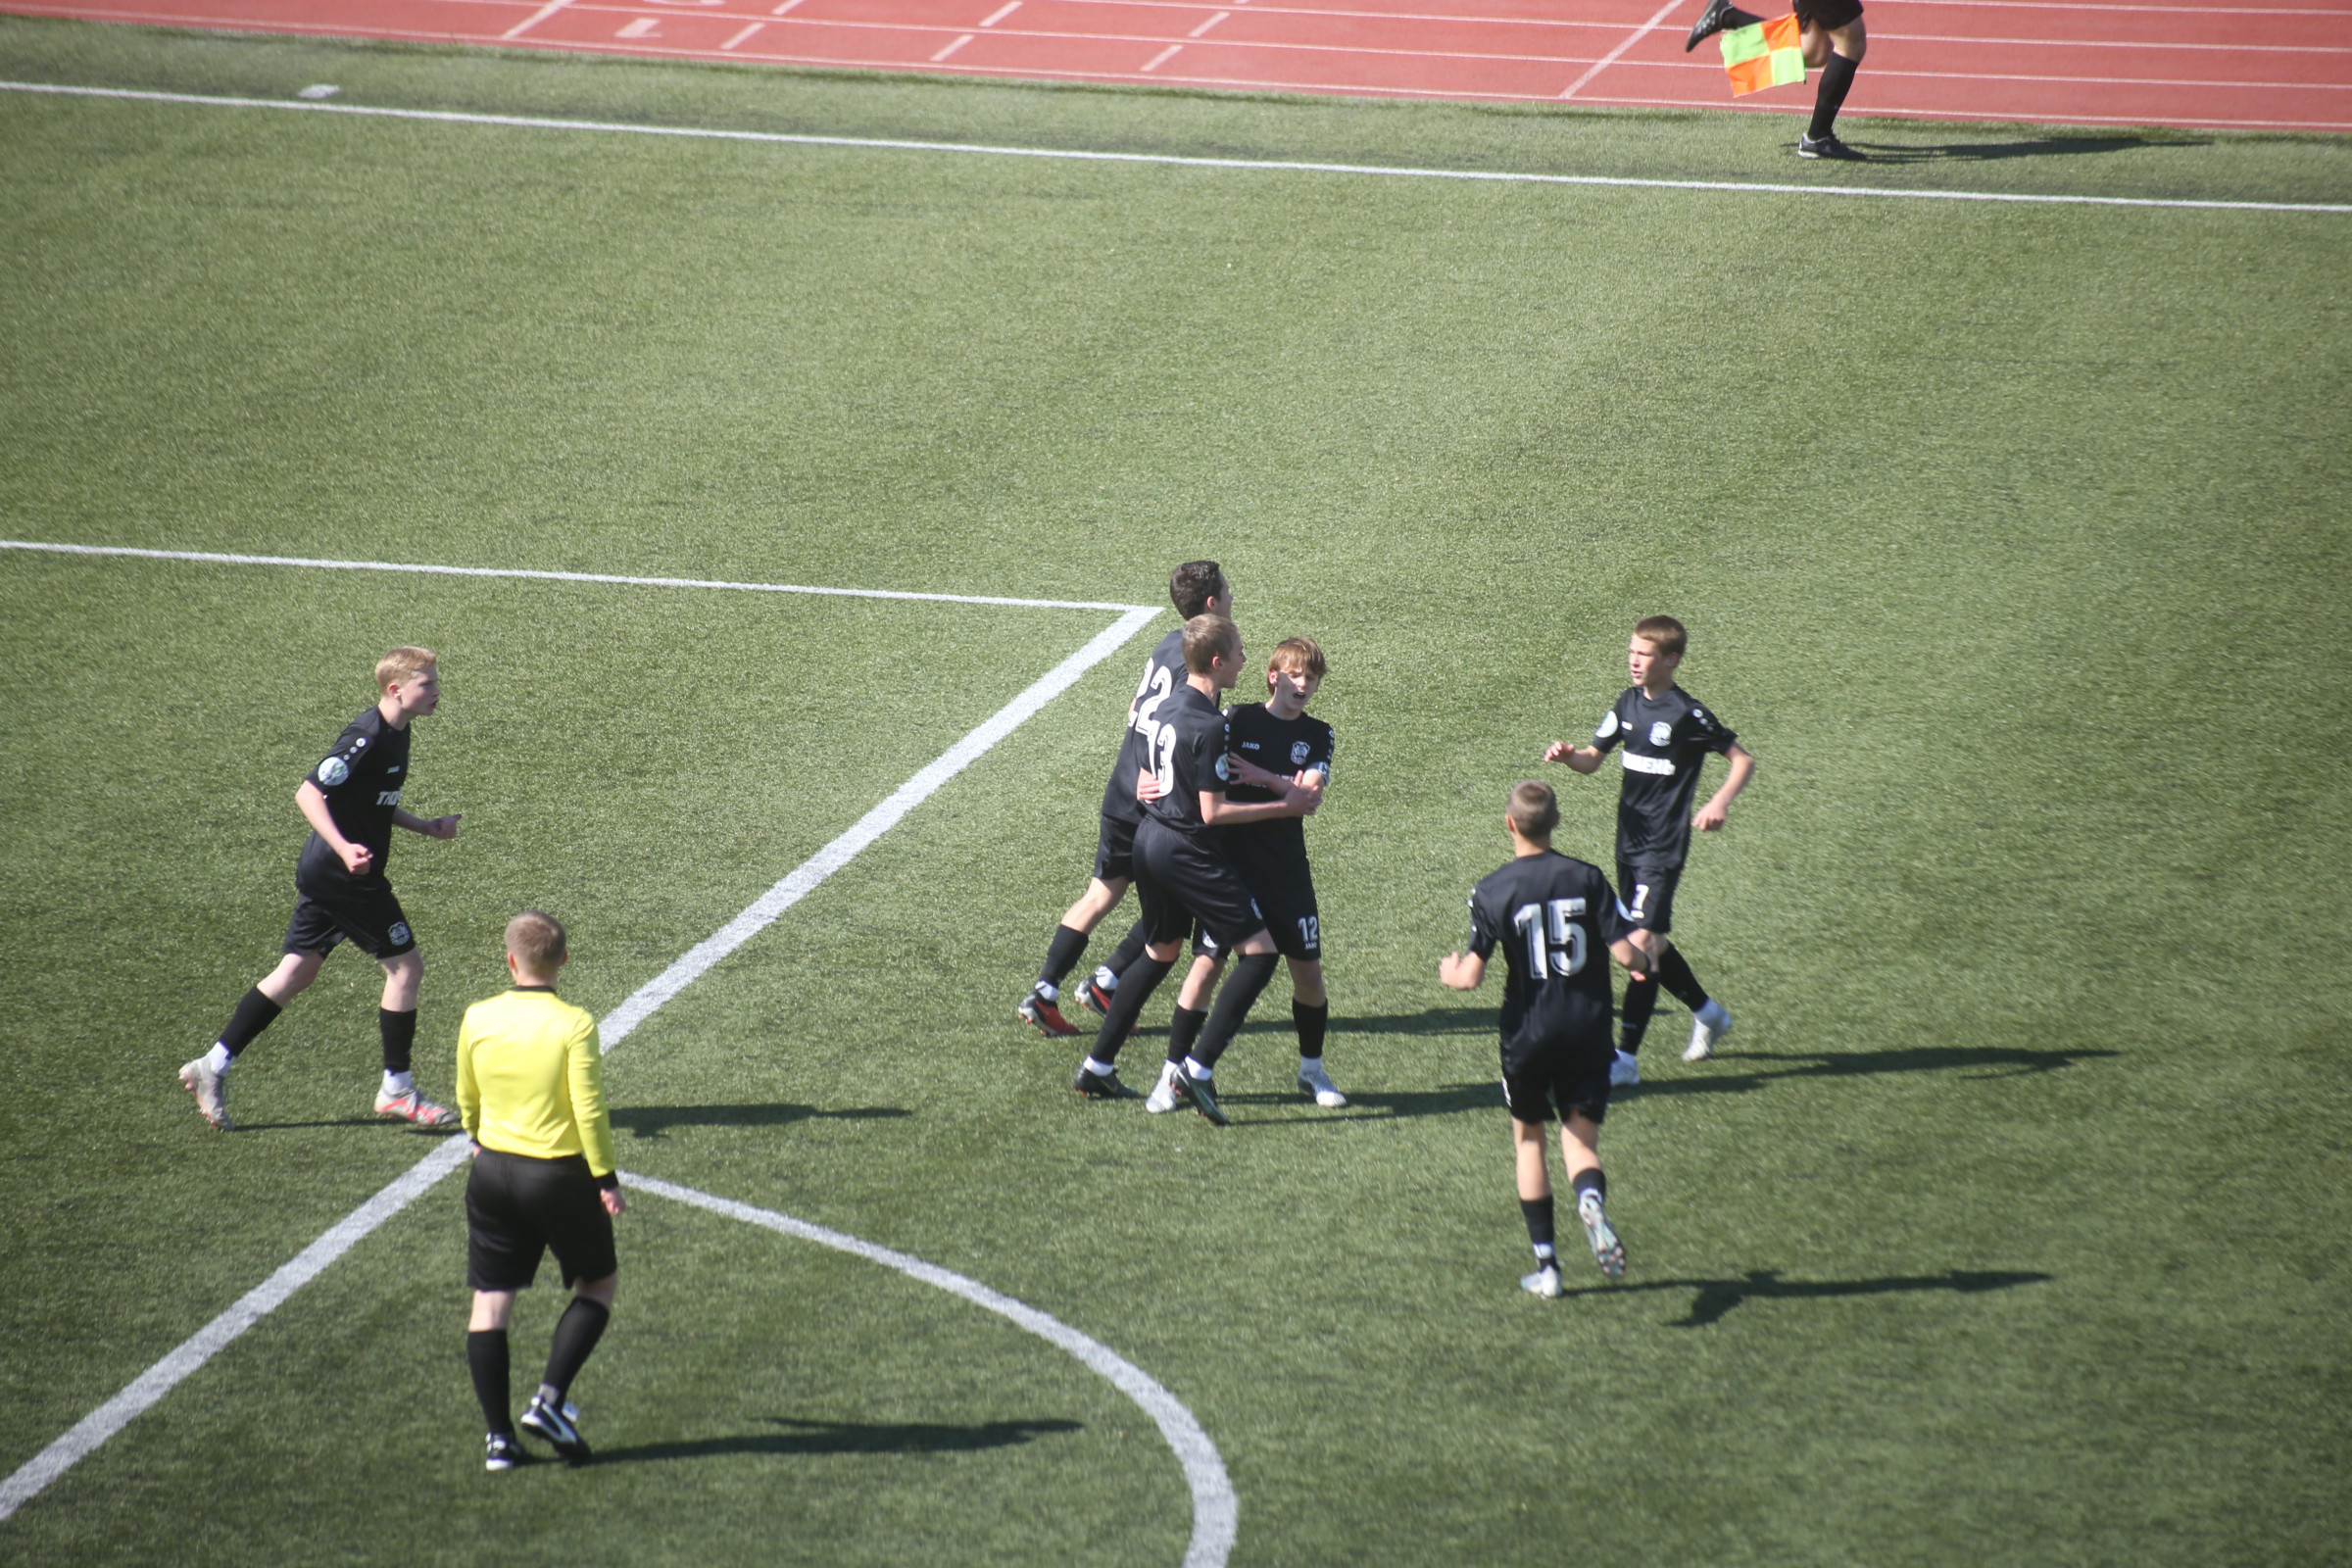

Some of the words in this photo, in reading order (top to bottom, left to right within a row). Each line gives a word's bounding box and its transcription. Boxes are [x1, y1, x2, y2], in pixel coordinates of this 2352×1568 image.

[1241, 741, 1260, 751] JAKO
[1298, 915, 1318, 943] 12
[1513, 897, 1588, 980] 15
